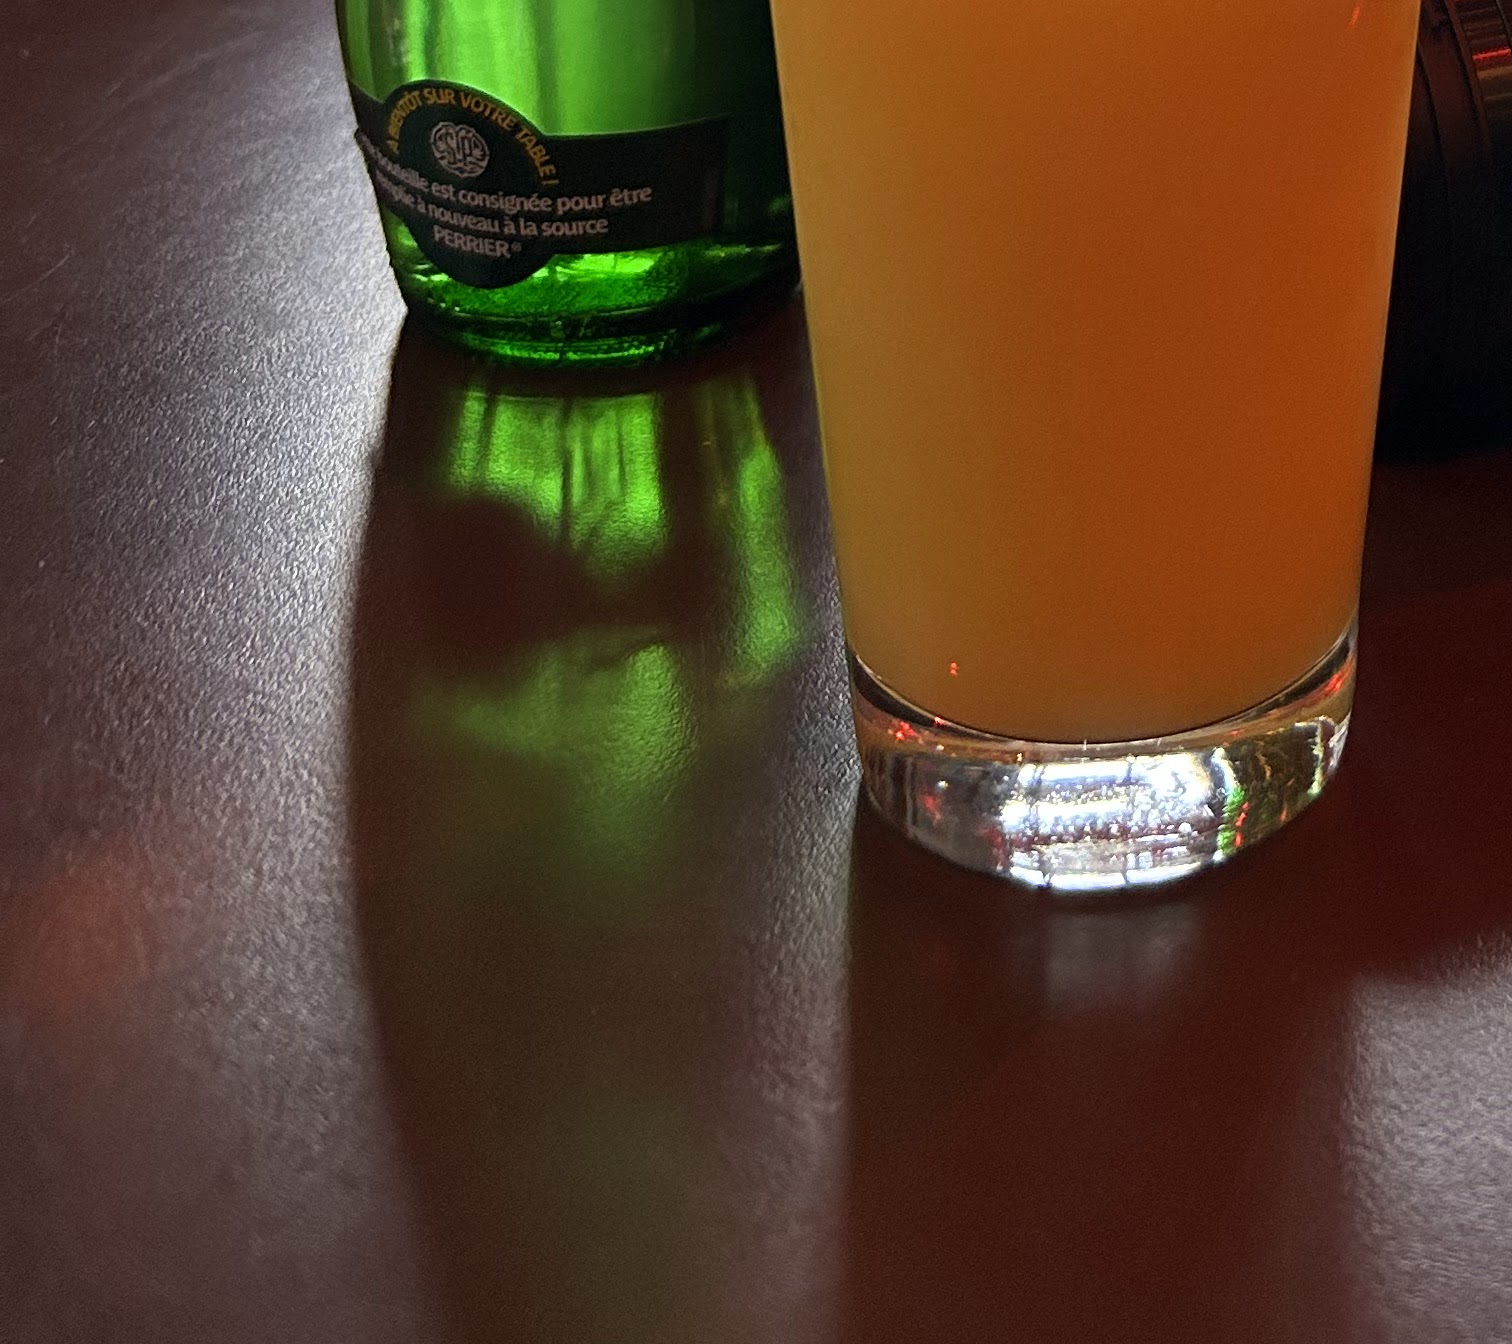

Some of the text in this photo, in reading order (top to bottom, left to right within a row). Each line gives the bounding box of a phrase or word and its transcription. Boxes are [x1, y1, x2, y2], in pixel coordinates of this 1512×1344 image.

[423, 87, 457, 107] SUR
[459, 92, 516, 131] VOTRE
[416, 195, 609, 237] à nouveau à la source
[430, 179, 456, 202] est
[458, 184, 553, 215] consignée
[556, 193, 606, 216] pour
[609, 184, 653, 208] être
